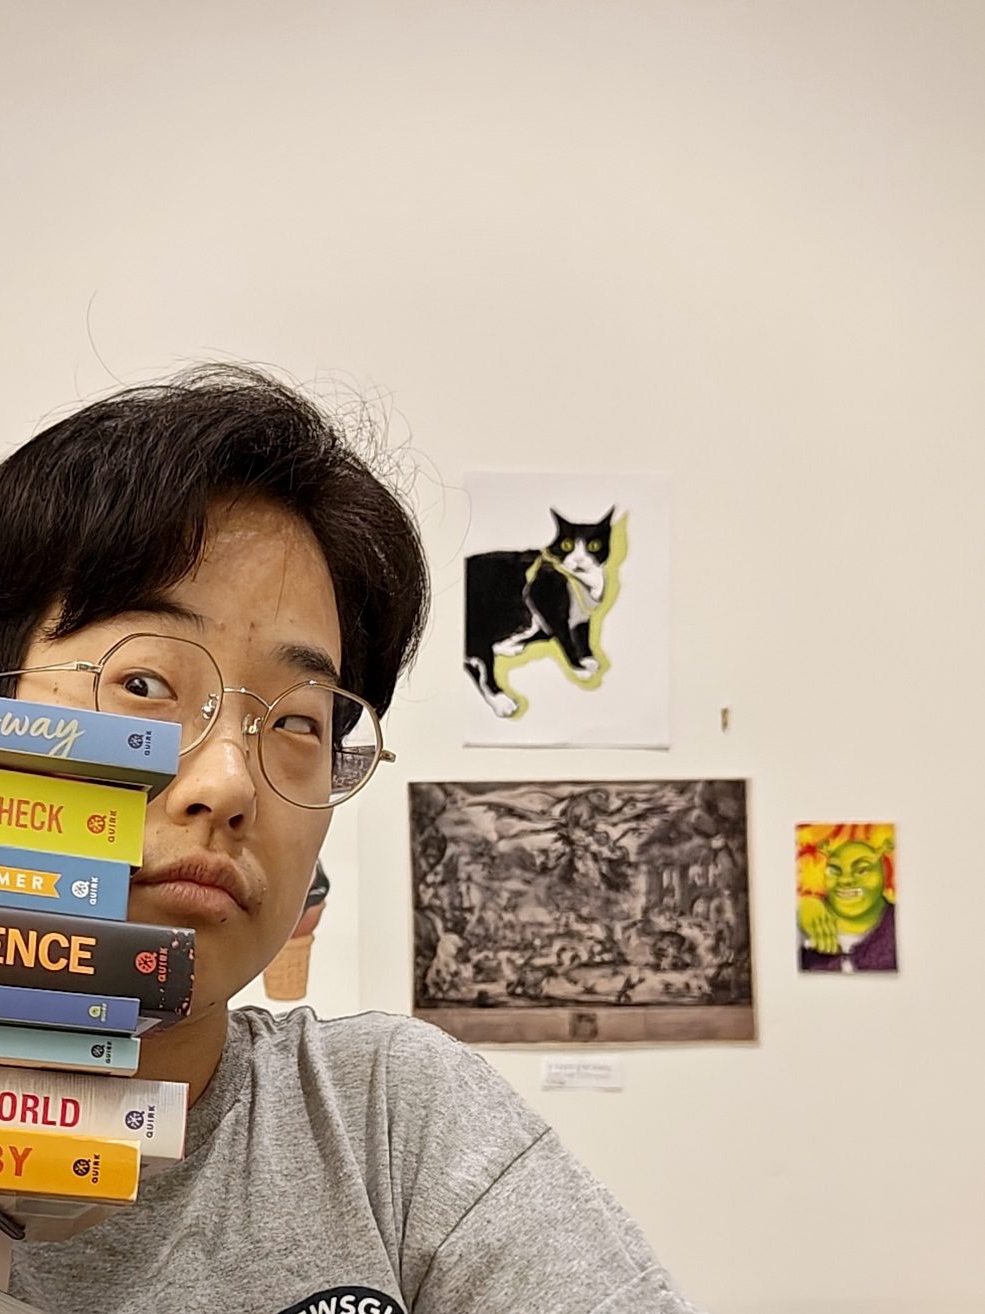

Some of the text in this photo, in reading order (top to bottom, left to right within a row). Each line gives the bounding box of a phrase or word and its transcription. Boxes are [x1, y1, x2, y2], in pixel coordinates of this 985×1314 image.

[143, 730, 152, 755] QUIRK
[108, 810, 117, 843] QUIRK
[89, 877, 99, 905] QUIRK
[157, 947, 169, 983] QUIRK
[146, 1105, 156, 1138] QUIRK
[91, 1153, 101, 1184] QUIRK
